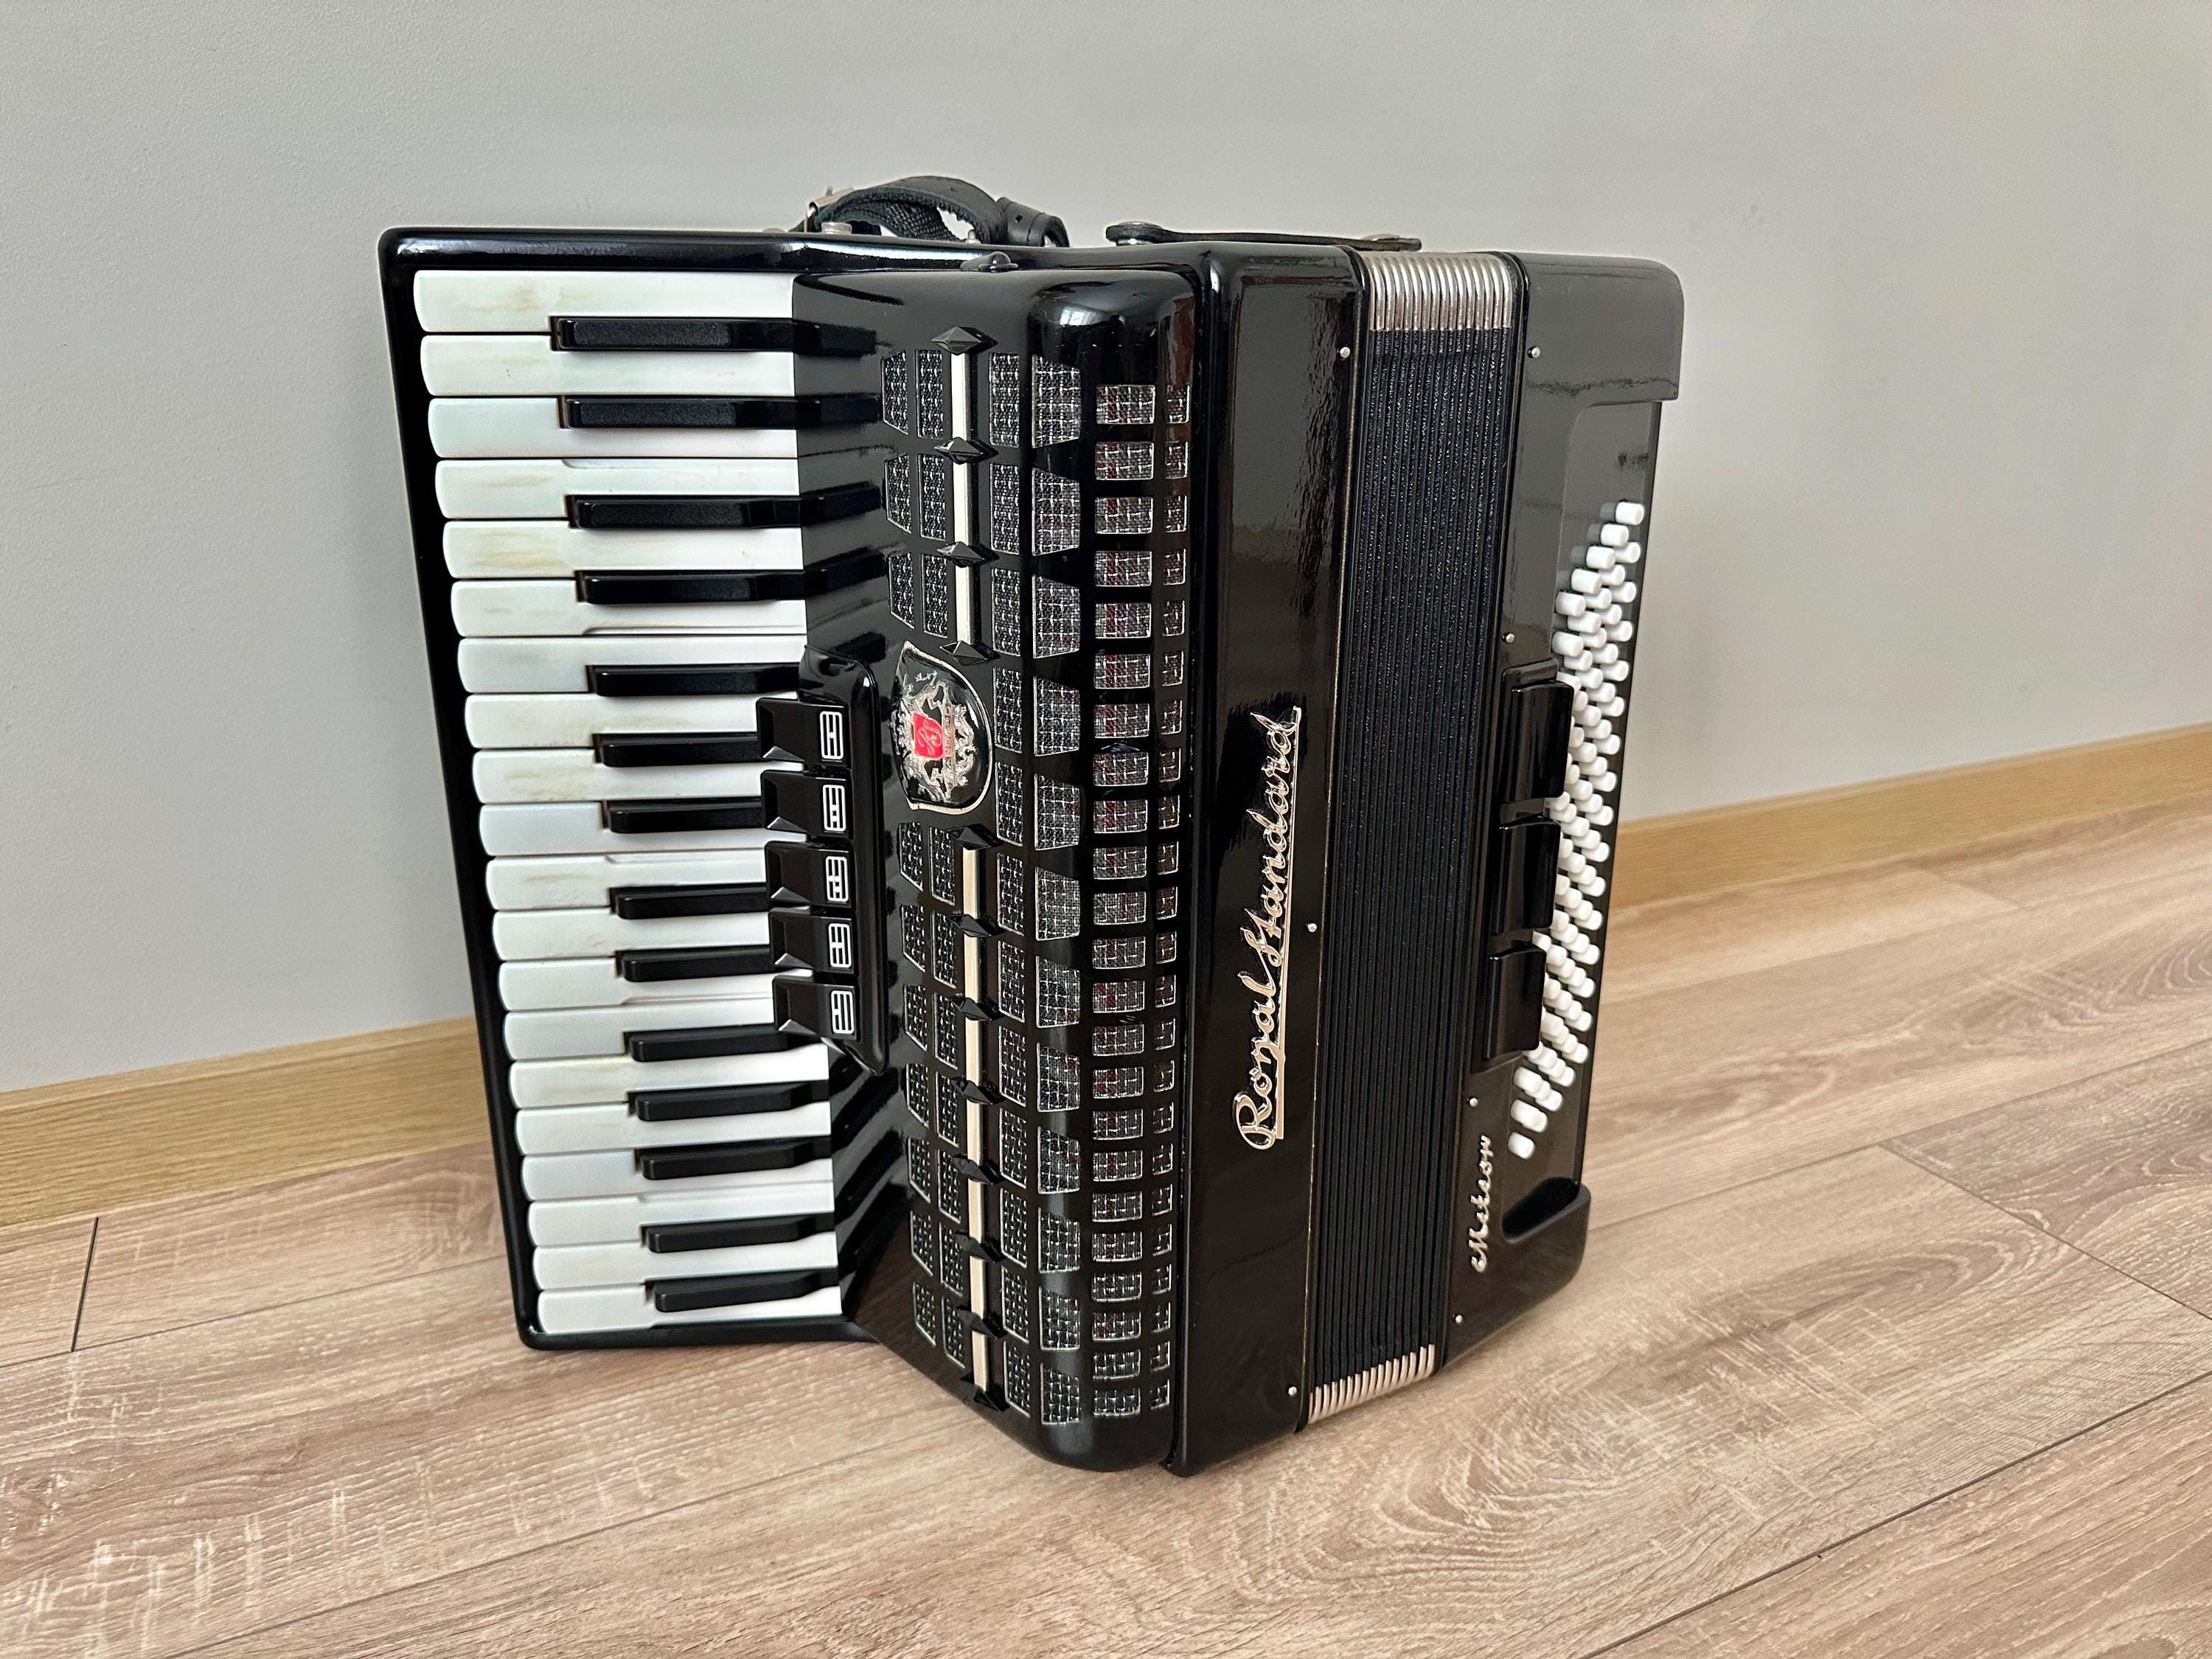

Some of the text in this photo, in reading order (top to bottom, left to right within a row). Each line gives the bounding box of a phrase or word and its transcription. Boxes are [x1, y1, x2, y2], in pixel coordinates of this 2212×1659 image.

[1234, 706, 1301, 1150] Royal Standard
[1469, 1135, 1494, 1272] Meteor
